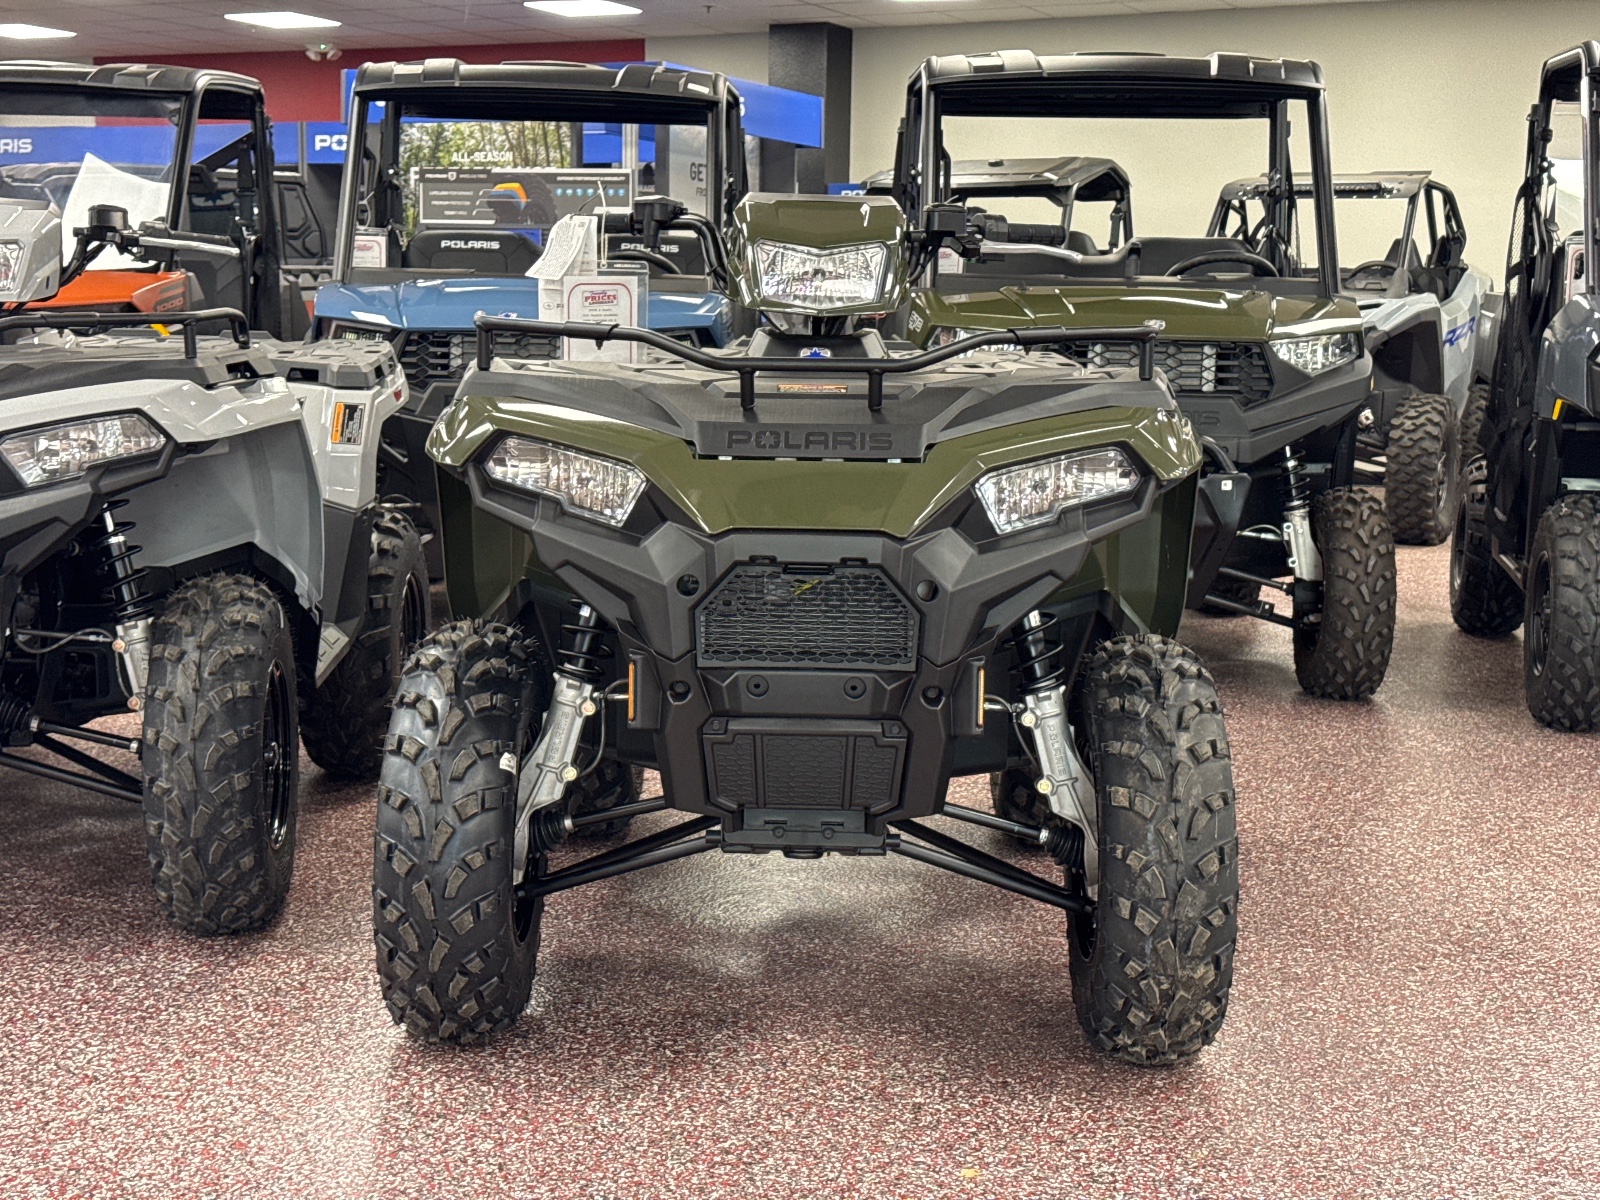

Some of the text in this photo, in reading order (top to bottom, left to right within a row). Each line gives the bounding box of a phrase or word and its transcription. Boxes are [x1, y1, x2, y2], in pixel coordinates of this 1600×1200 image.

[451, 151, 514, 162] ALL-SEASON
[440, 240, 500, 249] POLARIS
[157, 297, 184, 313] 1000
[584, 294, 617, 303] PRICES
[1442, 315, 1476, 348] RZR
[726, 430, 893, 451] POLARIS
[547, 710, 571, 764] POLARIS
[1046, 723, 1068, 777] POLARIS
